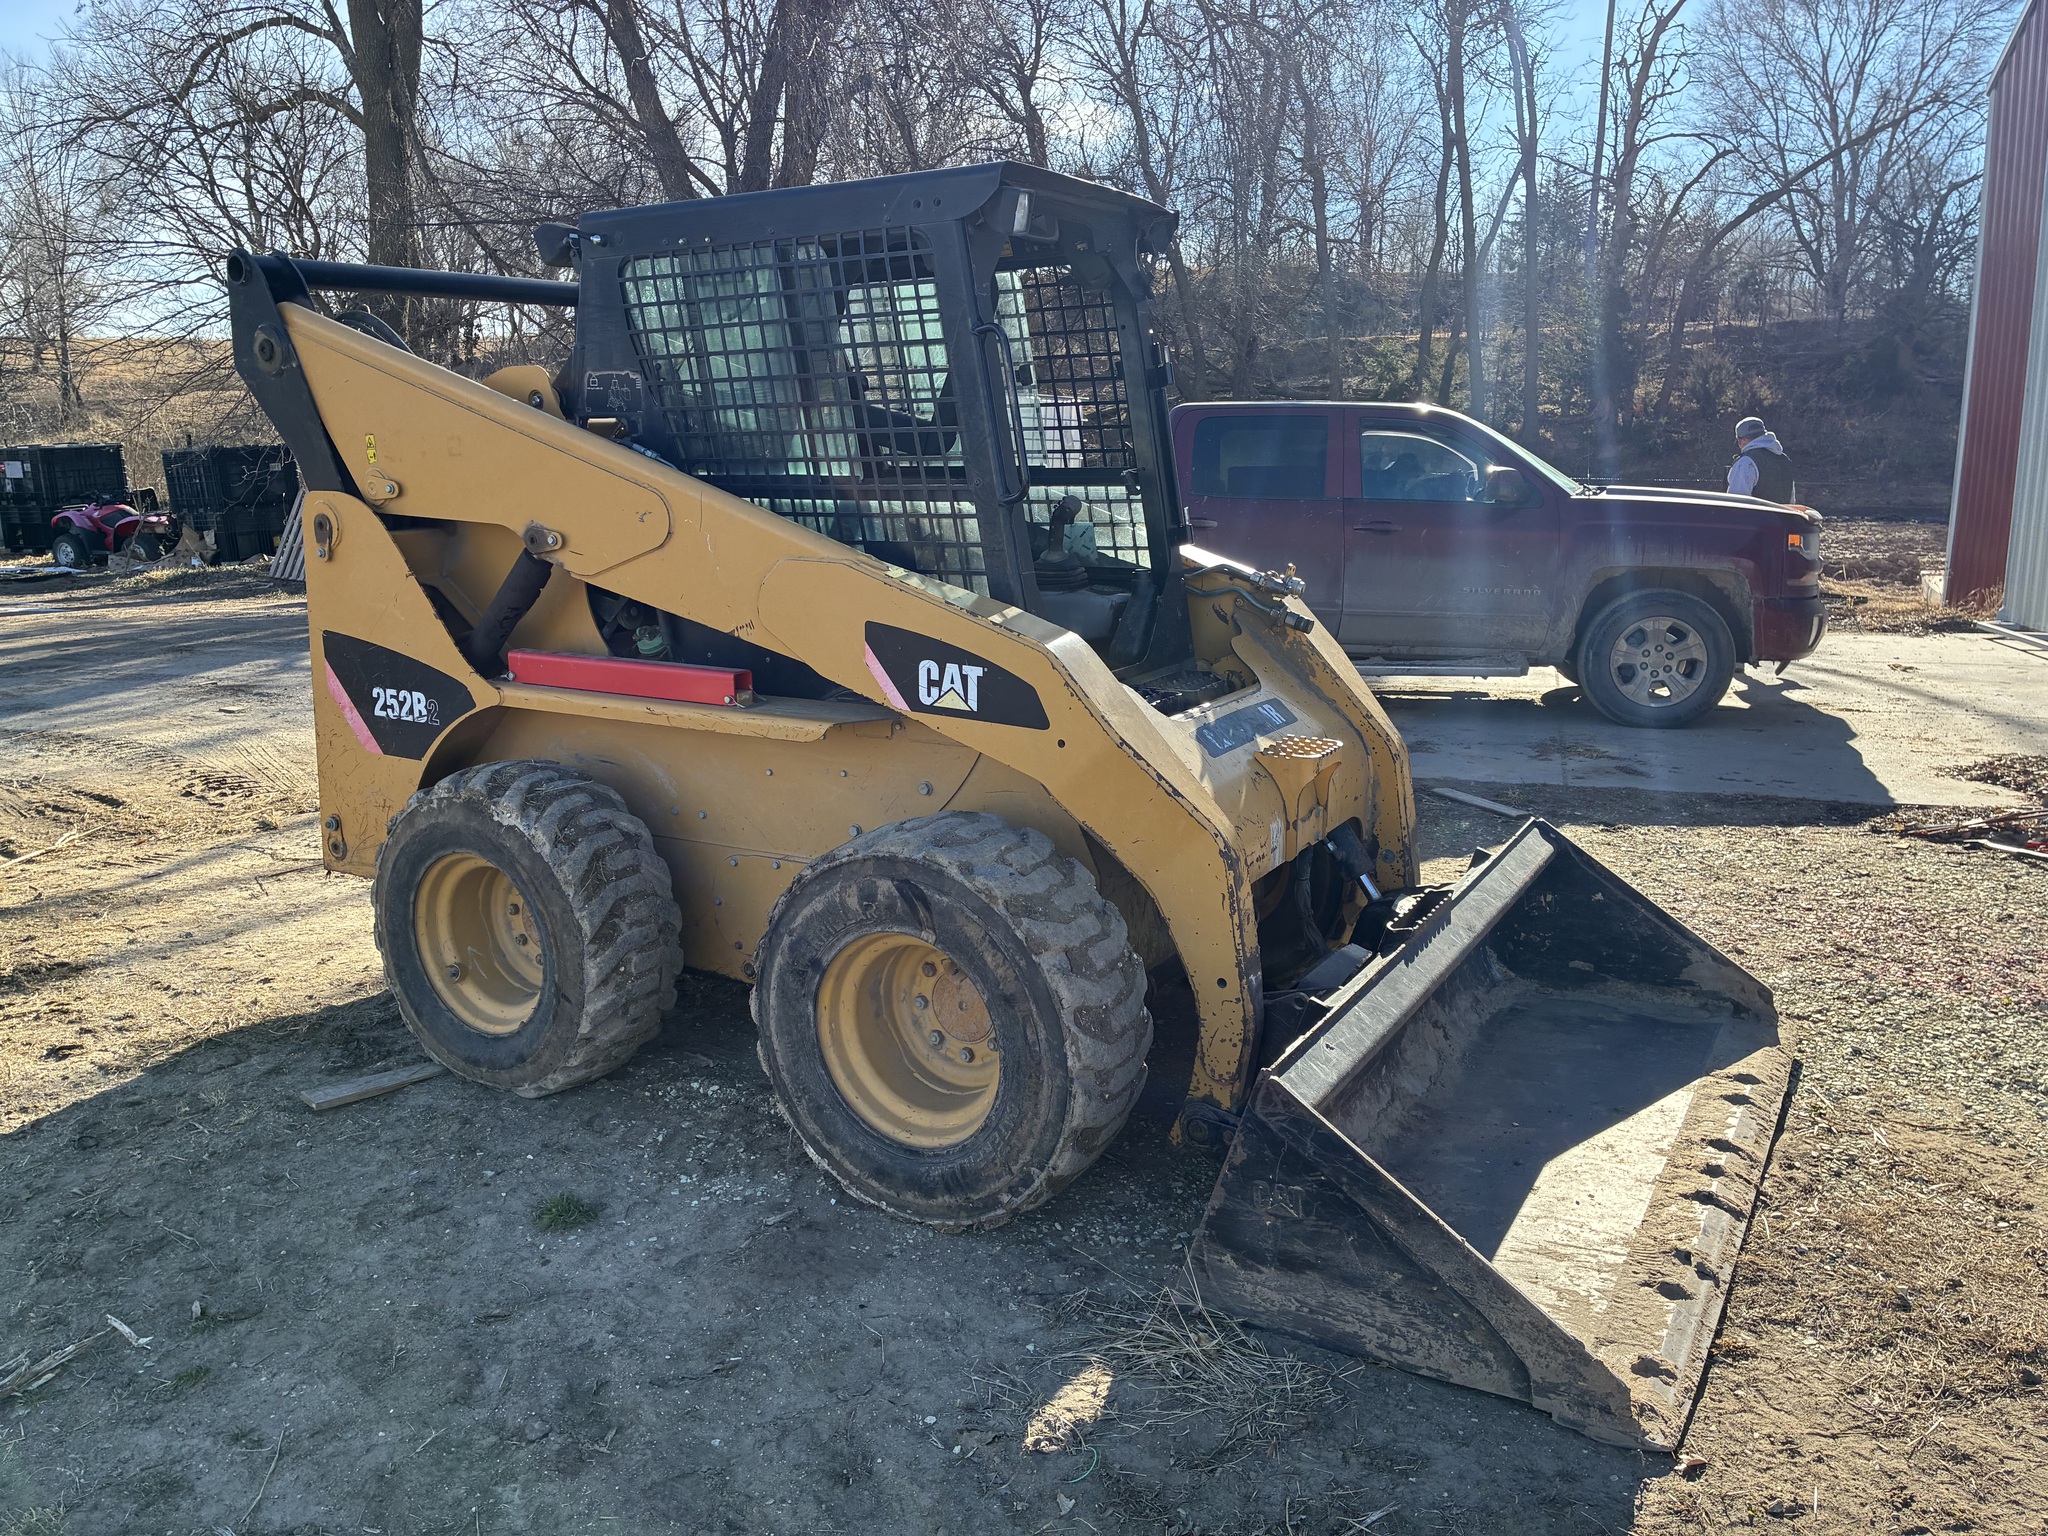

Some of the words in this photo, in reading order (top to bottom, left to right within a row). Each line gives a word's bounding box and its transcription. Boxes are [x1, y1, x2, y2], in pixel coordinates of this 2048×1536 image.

[1462, 586, 1541, 596] SILVERADO
[918, 659, 984, 712] CAT
[1252, 1180, 1305, 1219] CAT
